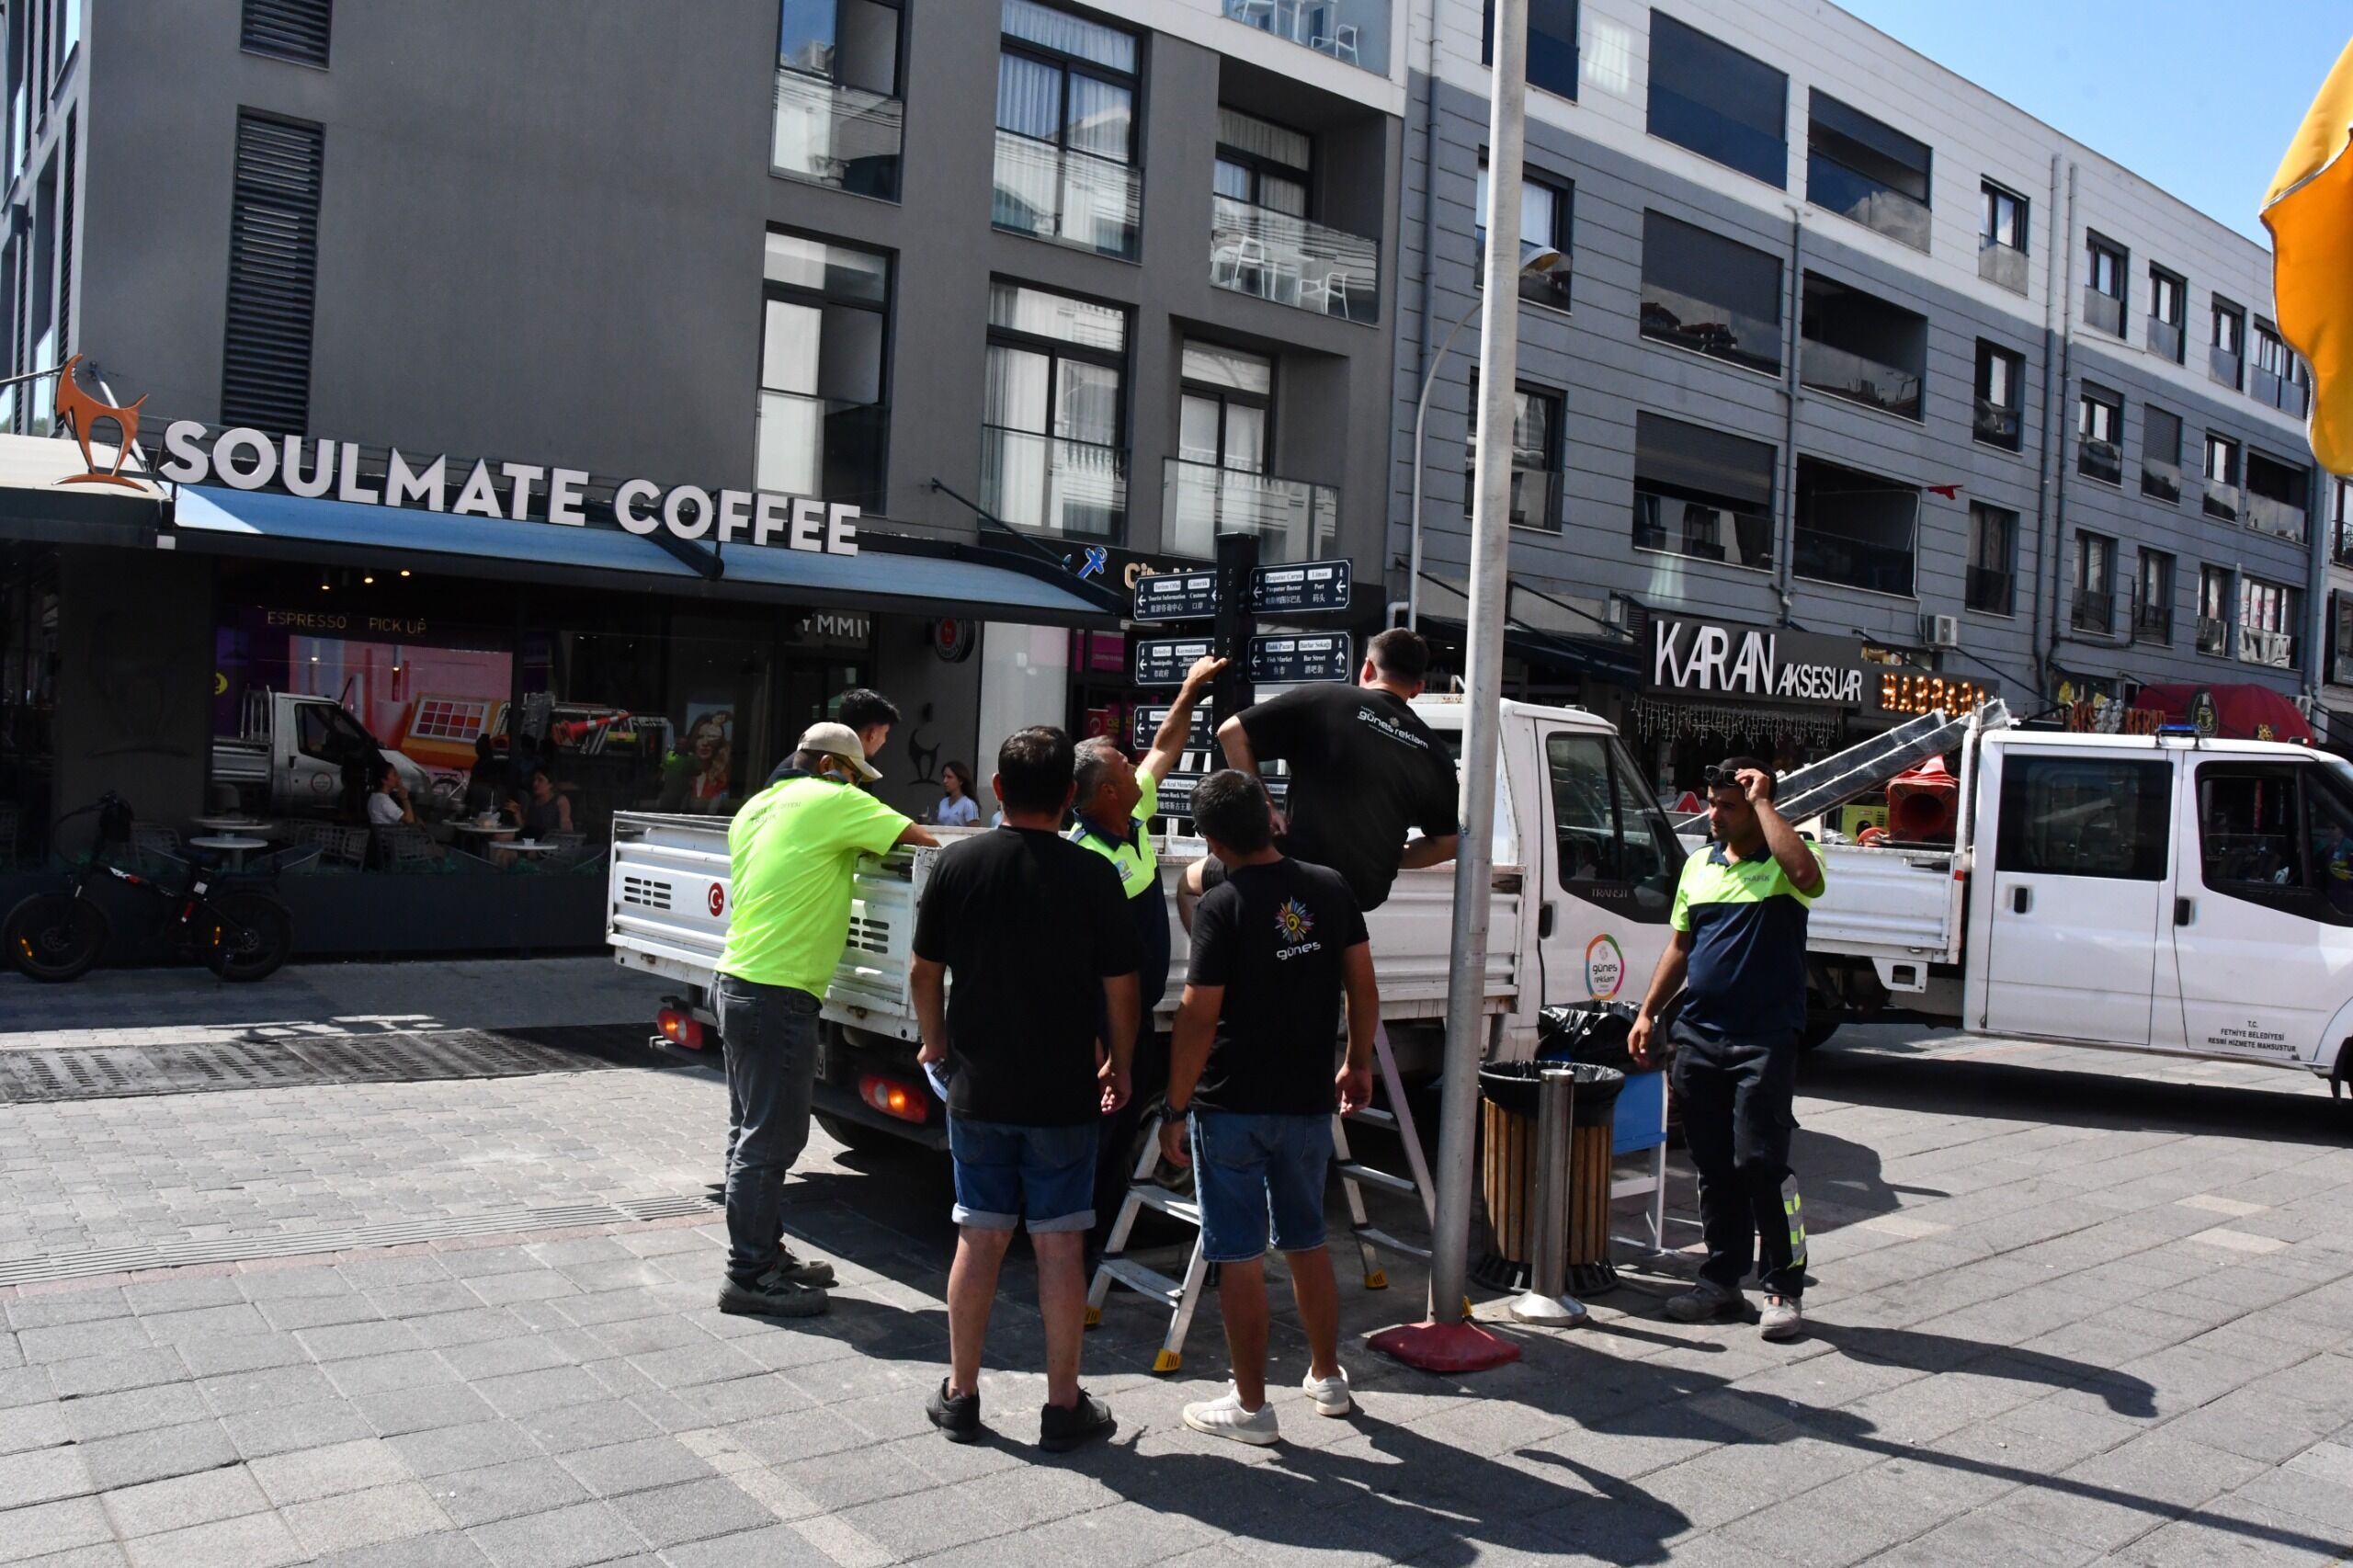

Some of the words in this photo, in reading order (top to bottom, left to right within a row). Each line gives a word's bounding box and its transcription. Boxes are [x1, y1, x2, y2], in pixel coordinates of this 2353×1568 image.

[159, 419, 589, 528] SOULMATE
[613, 478, 861, 556] COFFEE
[267, 611, 347, 630] ESPRESSO
[369, 617, 402, 632] PICK
[407, 621, 427, 634] UP
[1654, 619, 1776, 696] KARAN
[1775, 662, 1863, 702] AKSESUAR
[1394, 728, 1429, 750] reklam
[1591, 888, 1628, 898] TRANSIT
[1593, 974, 1616, 983] reklam
[2247, 1020, 2258, 1028] T.C.
[2220, 1028, 2247, 1039] FETHİYE
[2247, 1030, 2285, 1041] BELEDİYESİ
[2256, 1041, 2297, 1052] MAHSUSTUR
